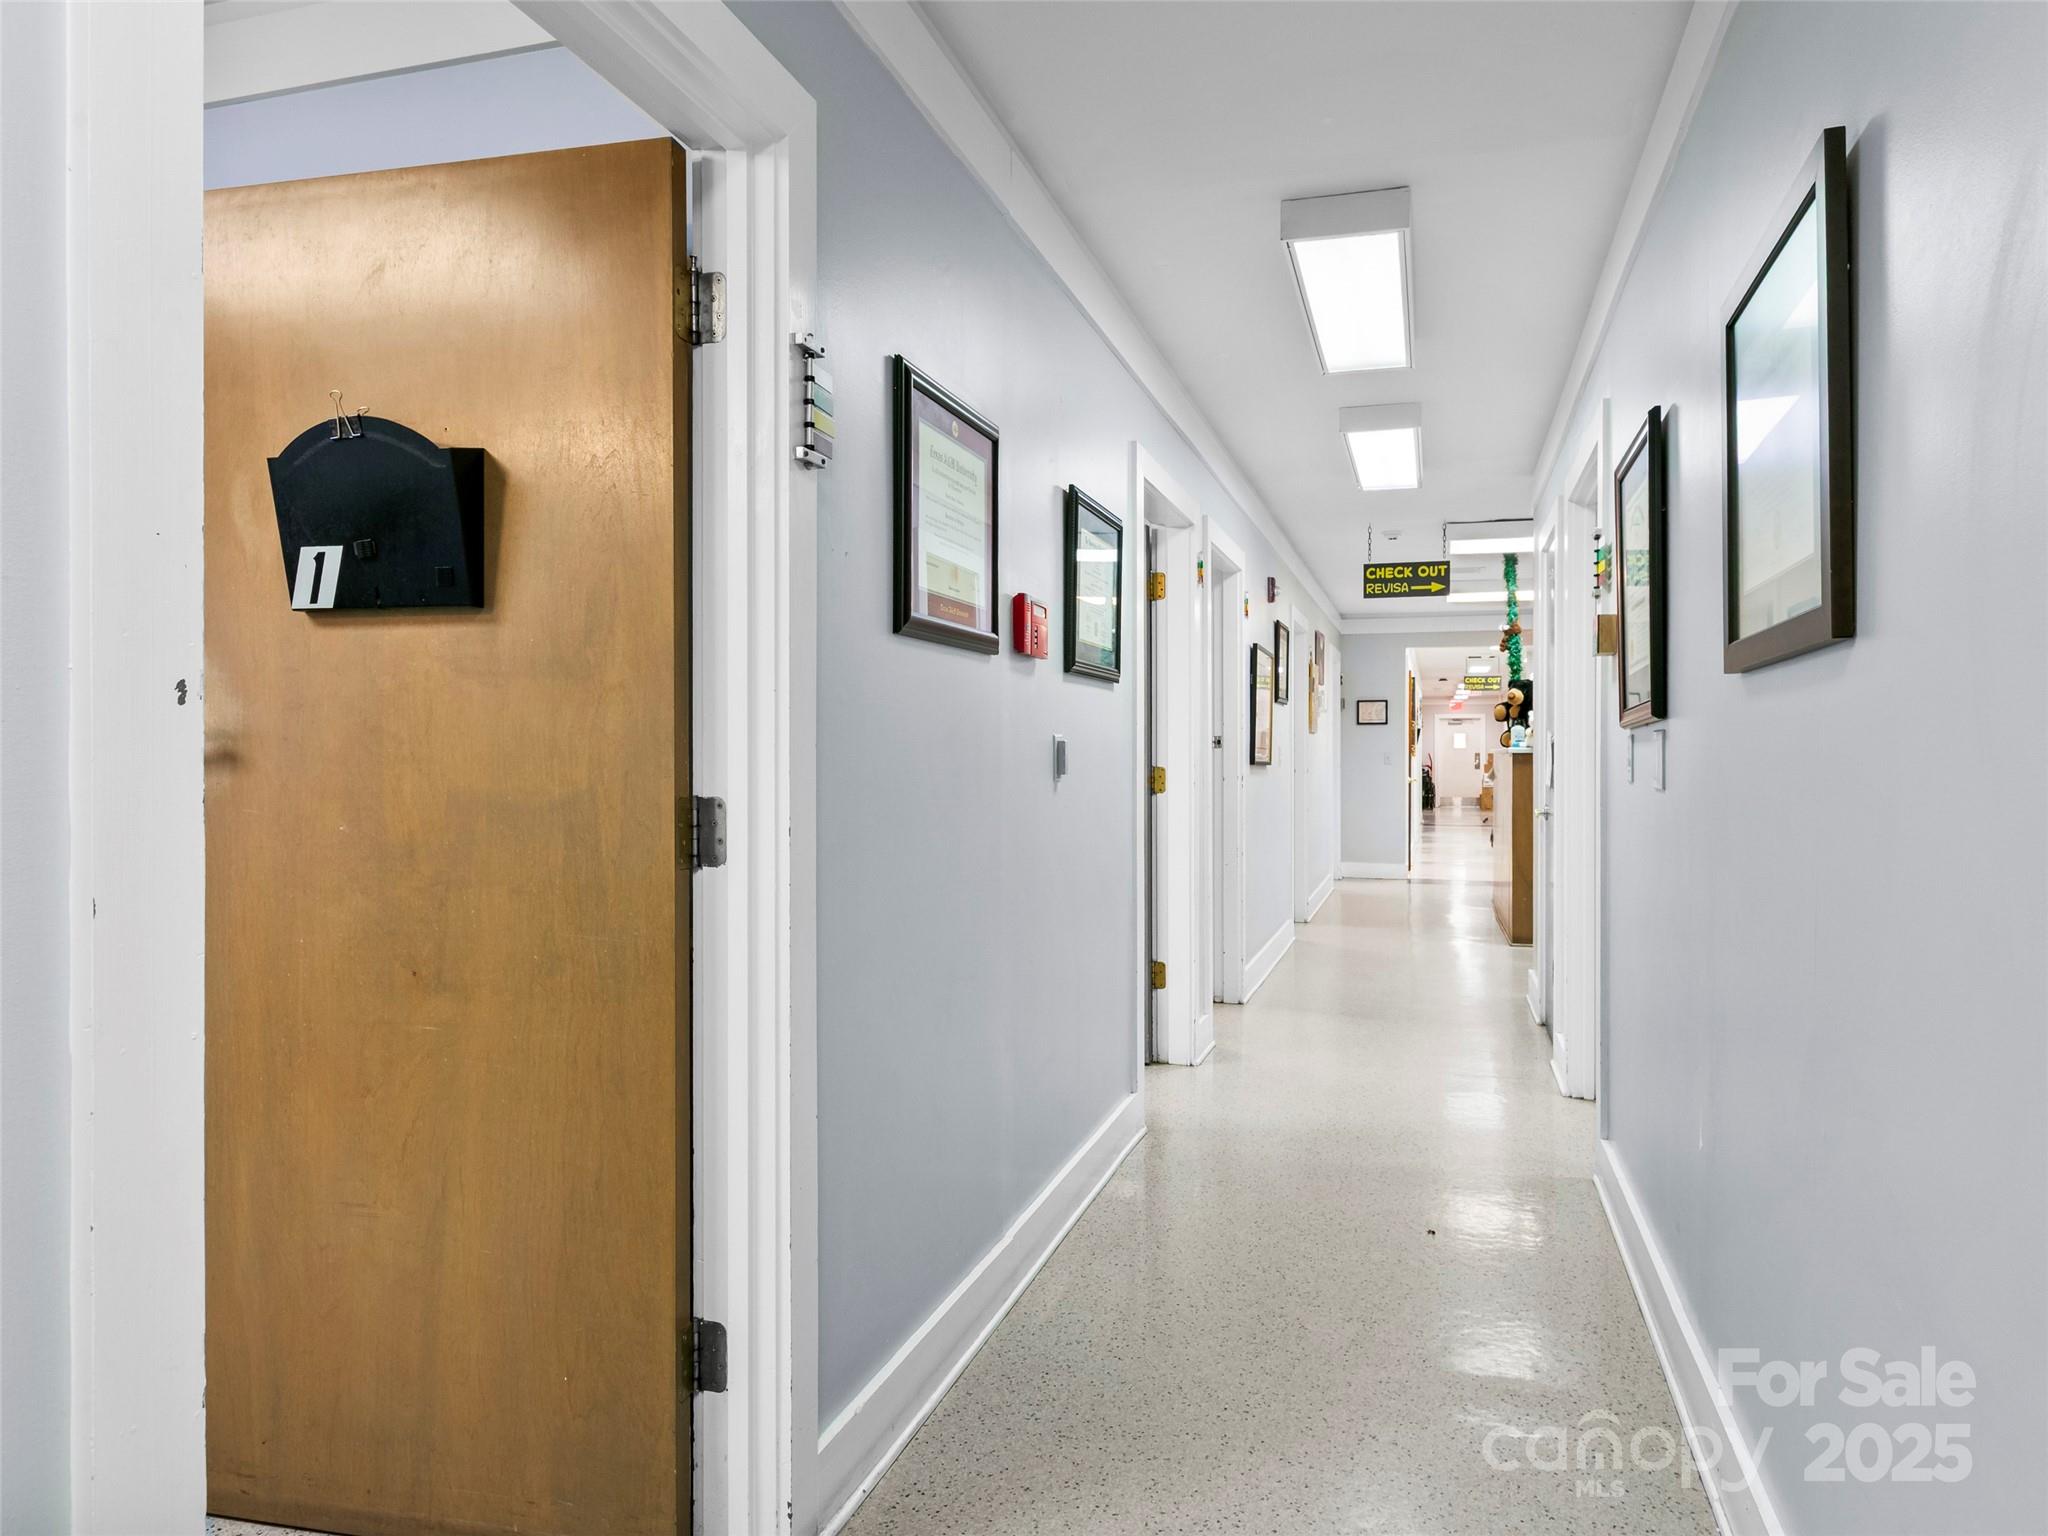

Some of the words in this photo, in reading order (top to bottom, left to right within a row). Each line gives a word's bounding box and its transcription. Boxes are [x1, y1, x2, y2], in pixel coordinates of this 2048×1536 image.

[309, 551, 326, 604] 1
[1366, 566, 1413, 580] CHECK
[1418, 565, 1448, 578] OUT
[1366, 582, 1409, 595] REVISA
